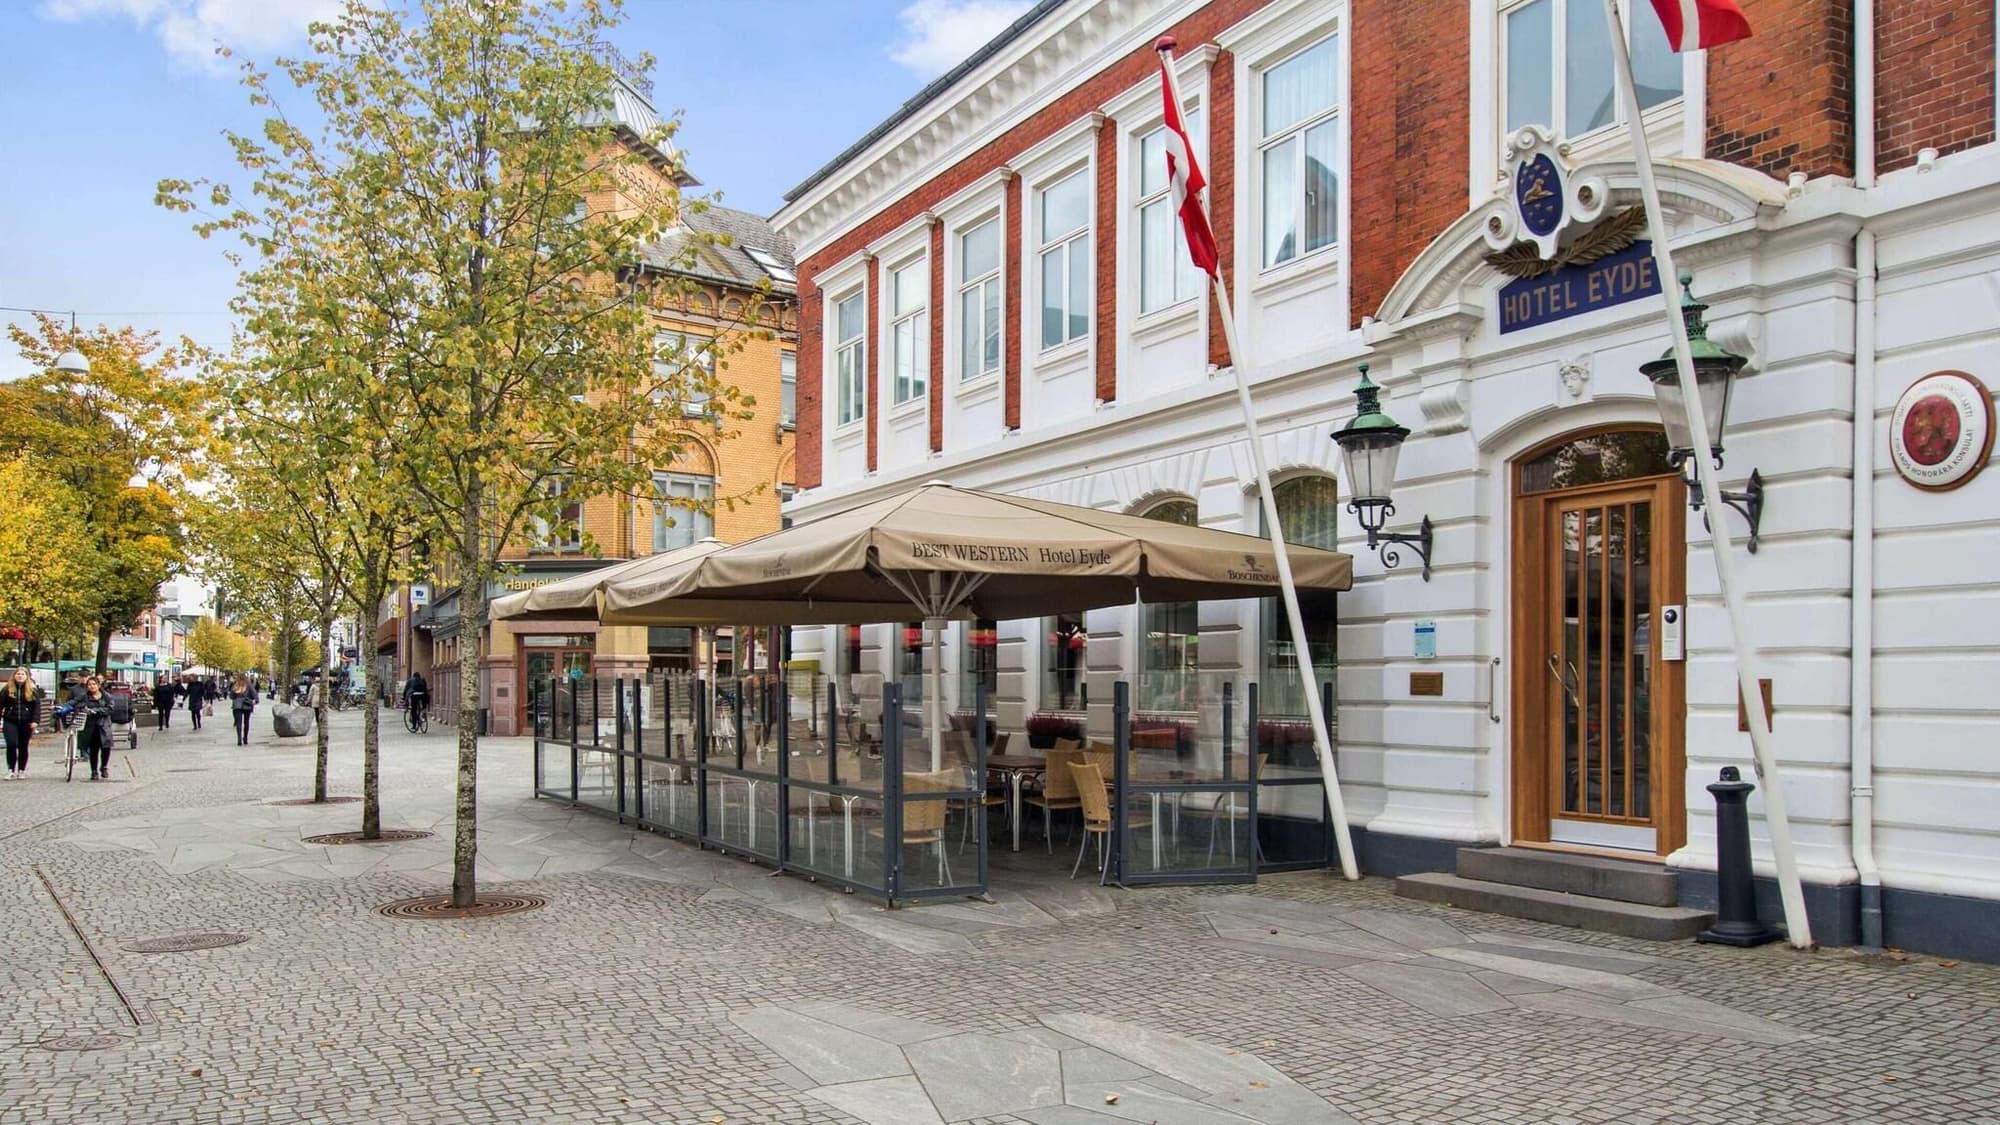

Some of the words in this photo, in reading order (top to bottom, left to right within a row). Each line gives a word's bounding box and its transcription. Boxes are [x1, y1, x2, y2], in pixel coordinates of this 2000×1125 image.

[1504, 280, 1577, 326] HOTEL
[1588, 255, 1653, 303] EYDE
[912, 542, 950, 558] BEST
[953, 544, 1029, 562] WESTERN
[1039, 547, 1076, 564] Hotel
[1079, 549, 1112, 568] Eyde
